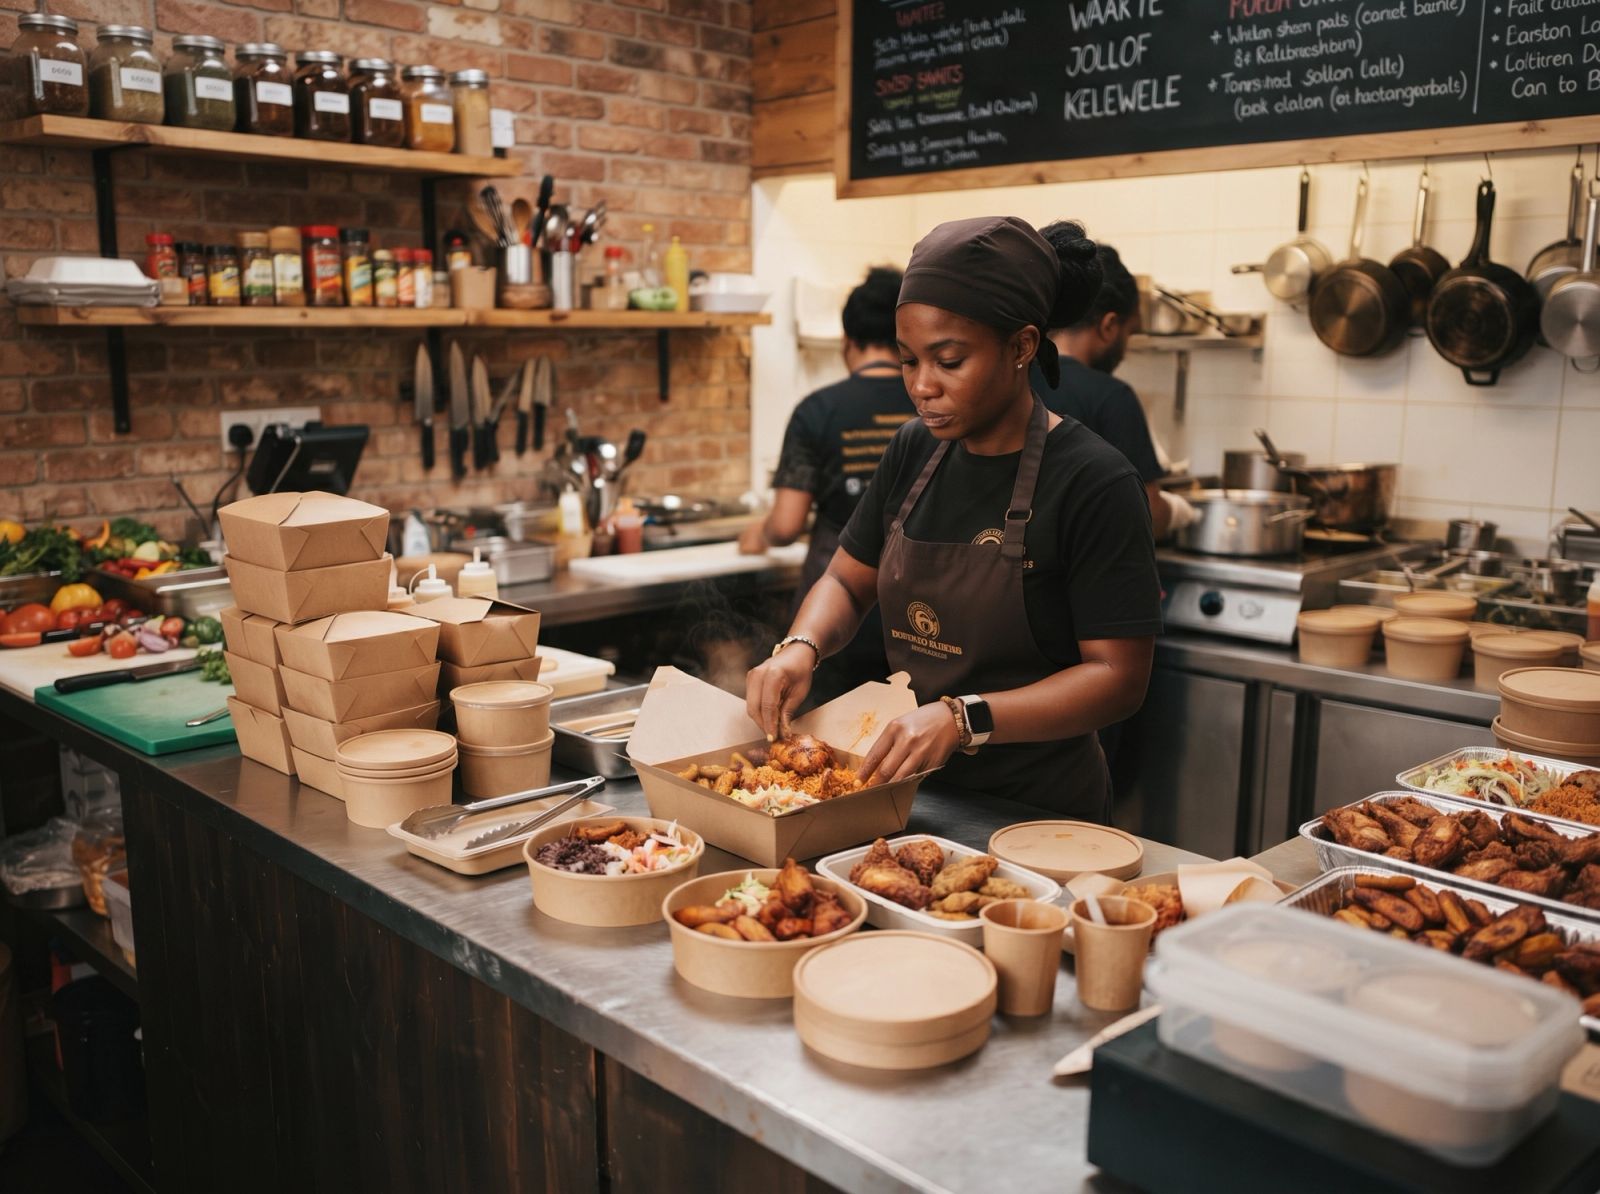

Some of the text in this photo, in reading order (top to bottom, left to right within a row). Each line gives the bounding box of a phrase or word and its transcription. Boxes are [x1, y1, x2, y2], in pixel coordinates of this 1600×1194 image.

[1065, 32, 1152, 77] JOLLOF
[1064, 74, 1182, 121] KELEWELE
[1511, 76, 1548, 99] Can
[1558, 74, 1577, 93] to
